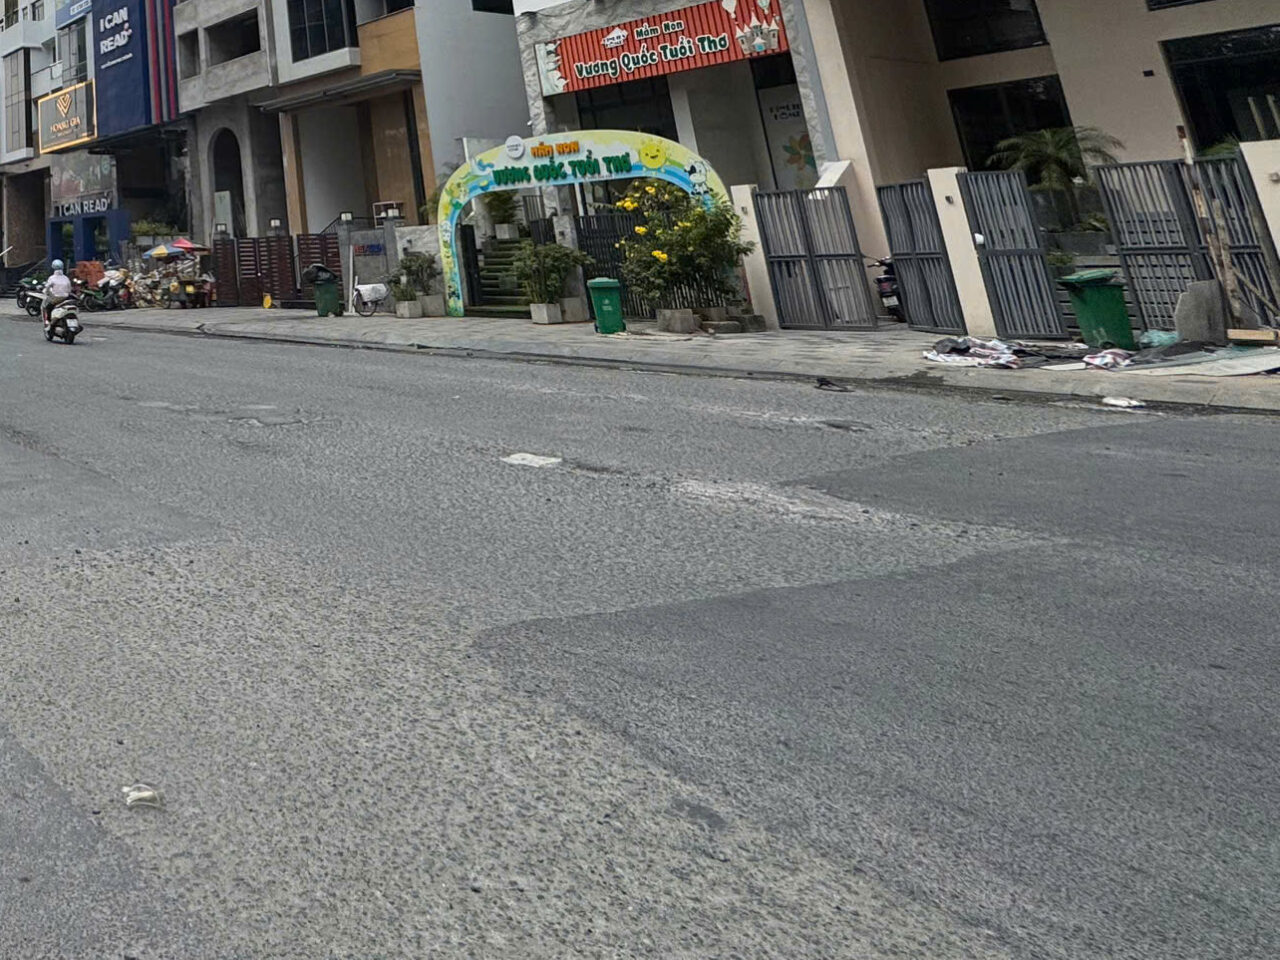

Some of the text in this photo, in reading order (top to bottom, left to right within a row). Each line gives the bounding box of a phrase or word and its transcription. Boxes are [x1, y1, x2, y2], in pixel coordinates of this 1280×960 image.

[100, 7, 128, 33] I CAN
[662, 21, 684, 34] Non
[100, 30, 129, 54] READ
[575, 34, 728, 77] Vương Quốc Tuổi Thơ
[556, 140, 579, 155] NON
[63, 202, 81, 217] CAN
[82, 198, 108, 214] READ
